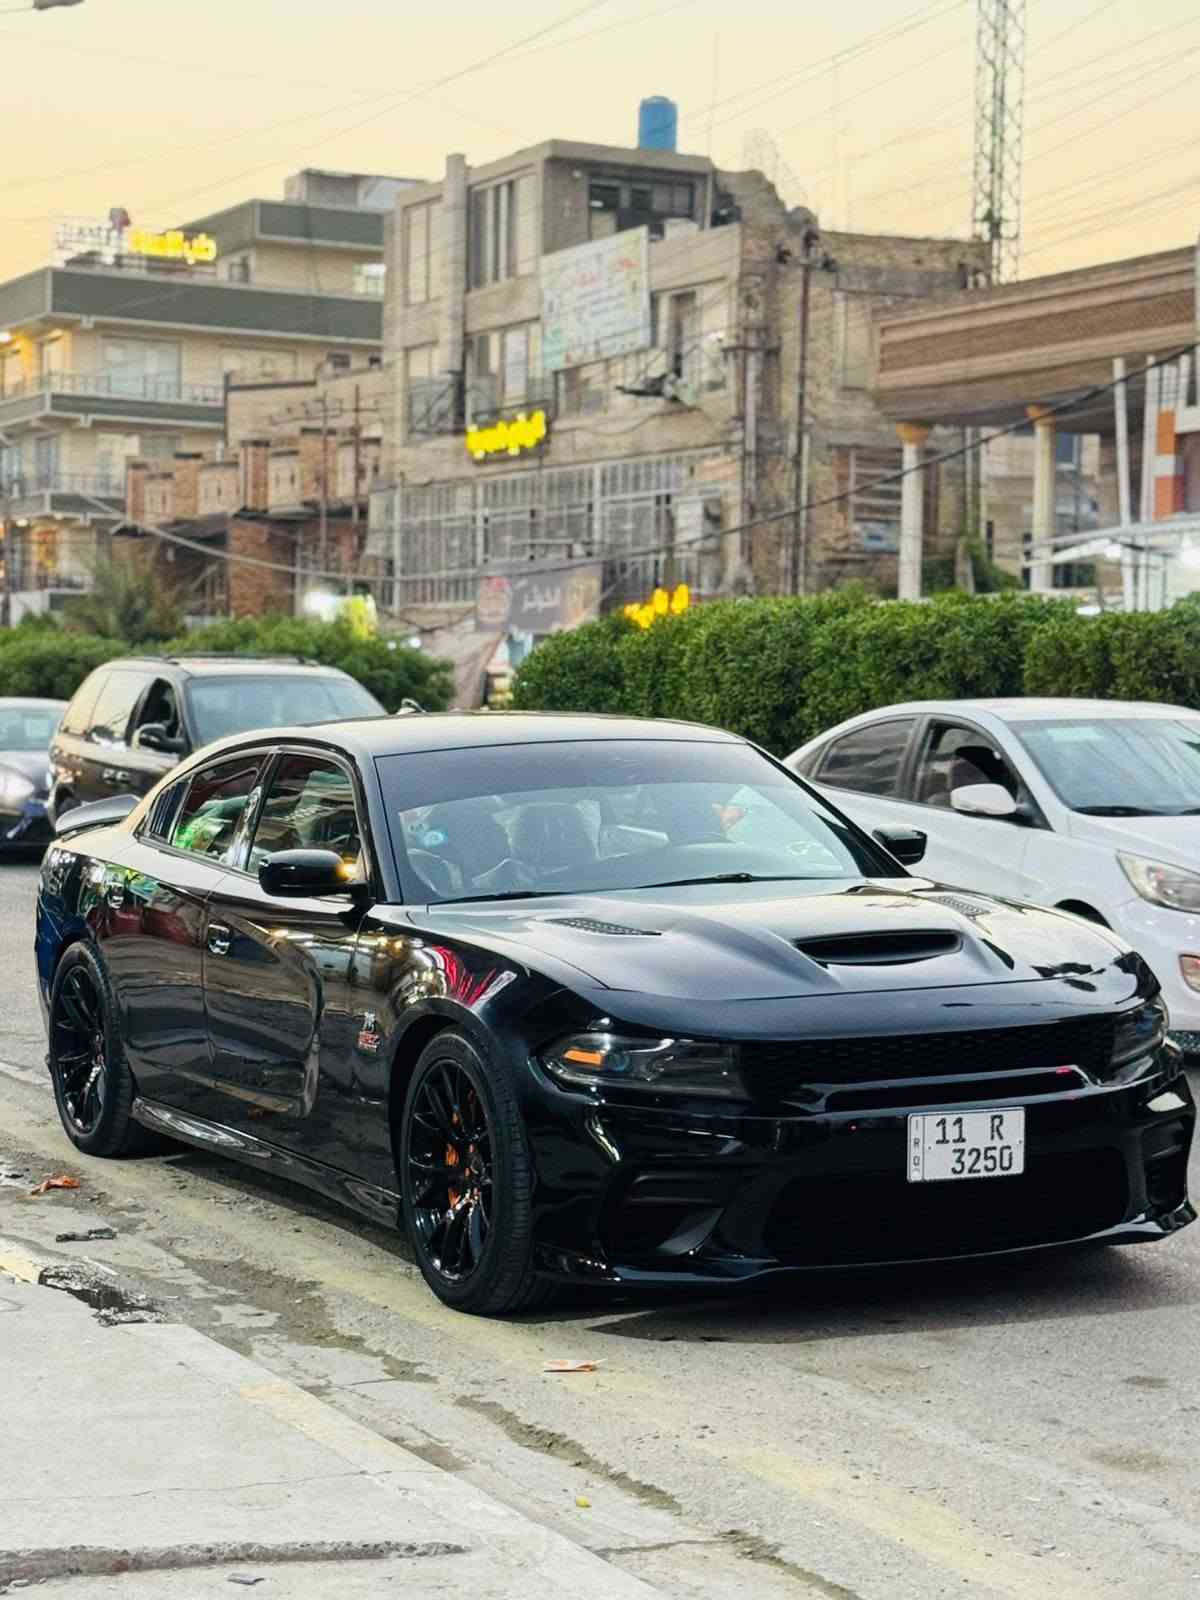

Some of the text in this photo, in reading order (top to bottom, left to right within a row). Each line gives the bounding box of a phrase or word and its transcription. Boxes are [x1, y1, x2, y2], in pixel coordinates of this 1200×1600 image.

[935, 1114, 1004, 1144] 11 R
[951, 1145, 1013, 1175] 3250
